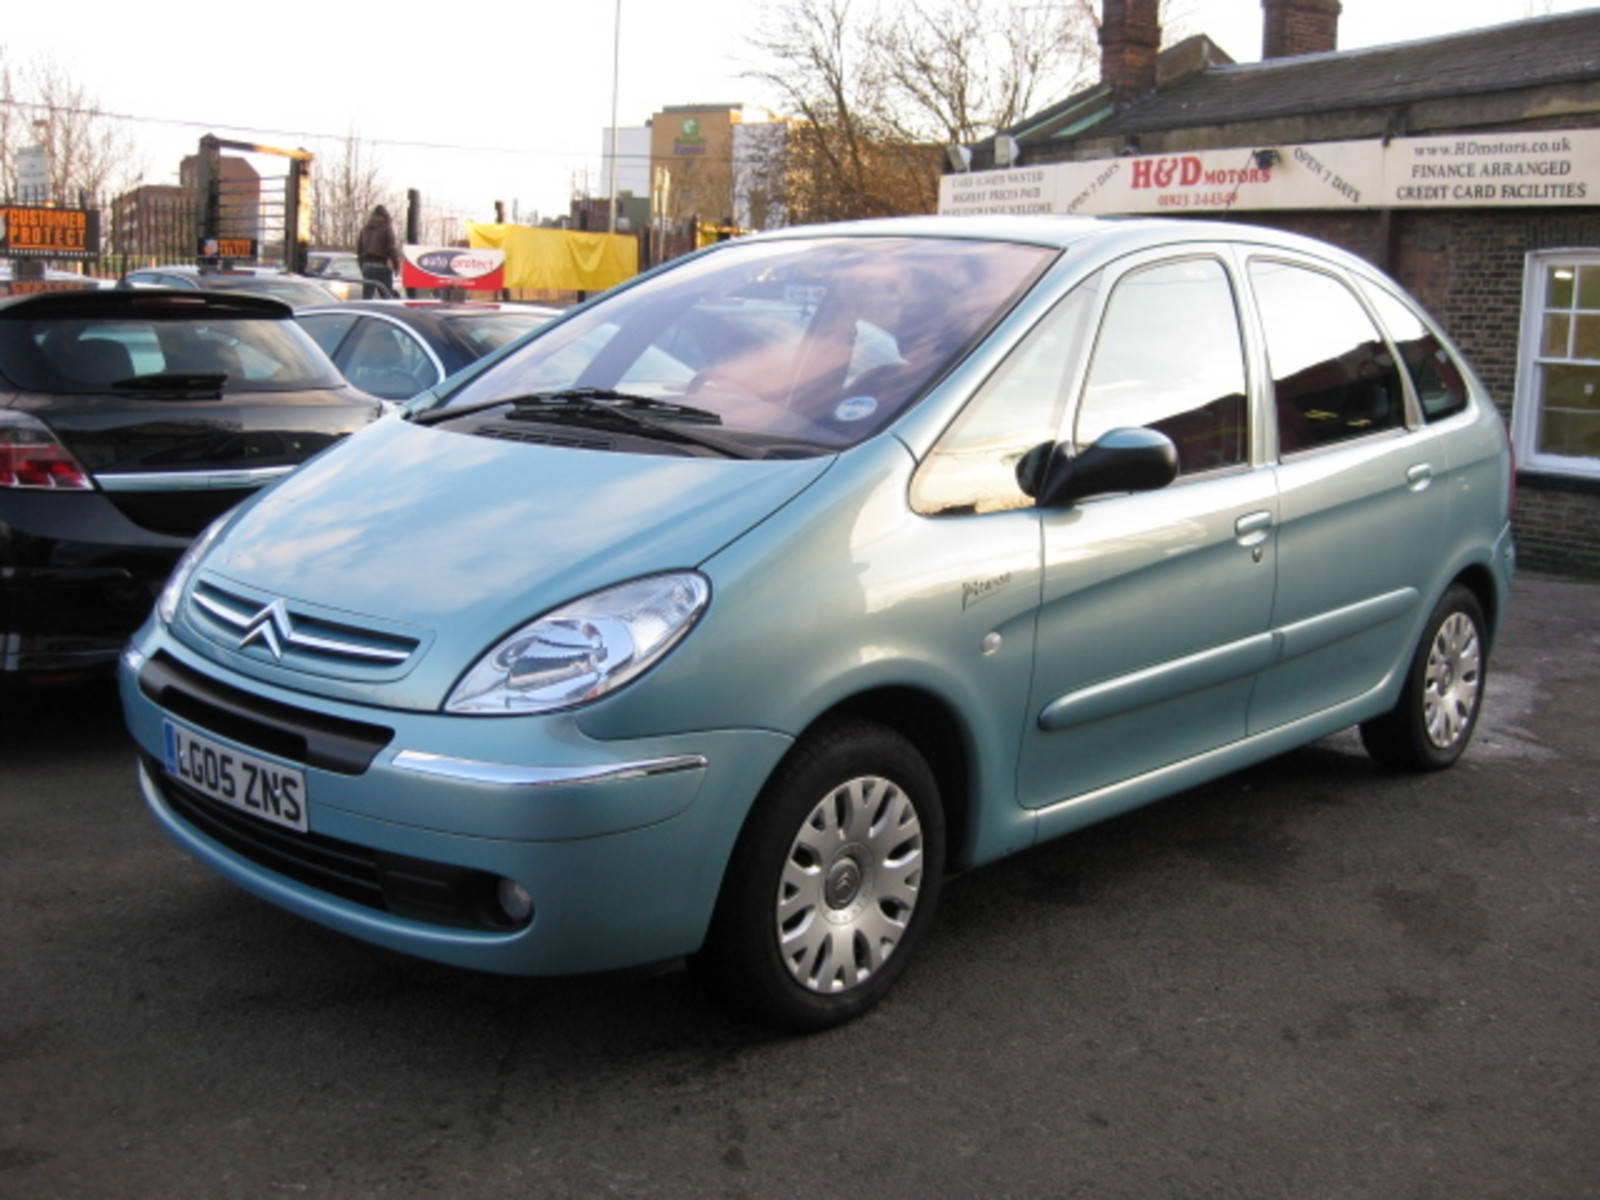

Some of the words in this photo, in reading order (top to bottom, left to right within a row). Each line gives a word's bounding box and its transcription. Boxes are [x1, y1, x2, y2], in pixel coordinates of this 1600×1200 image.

[1415, 138, 1571, 156] www.HDmotors.co.uk
[1097, 162, 1120, 186] DAYS
[1131, 157, 1202, 188] H&D
[1205, 168, 1271, 184] MOTORS
[1294, 147, 1323, 175] OPEN
[1323, 169, 1330, 182] 7
[1332, 175, 1361, 203] DAYS
[1412, 163, 1475, 178] FINANCE
[1480, 160, 1571, 177] ARRANGED
[1396, 185, 1448, 200] CREDIT
[1452, 184, 1496, 199] CARD
[1502, 182, 1587, 198] FACILITIES
[9, 208, 86, 228] CUSTOMER
[10, 226, 86, 246] PROTECT
[177, 733, 236, 798] LG05
[241, 761, 302, 822] ZNS
